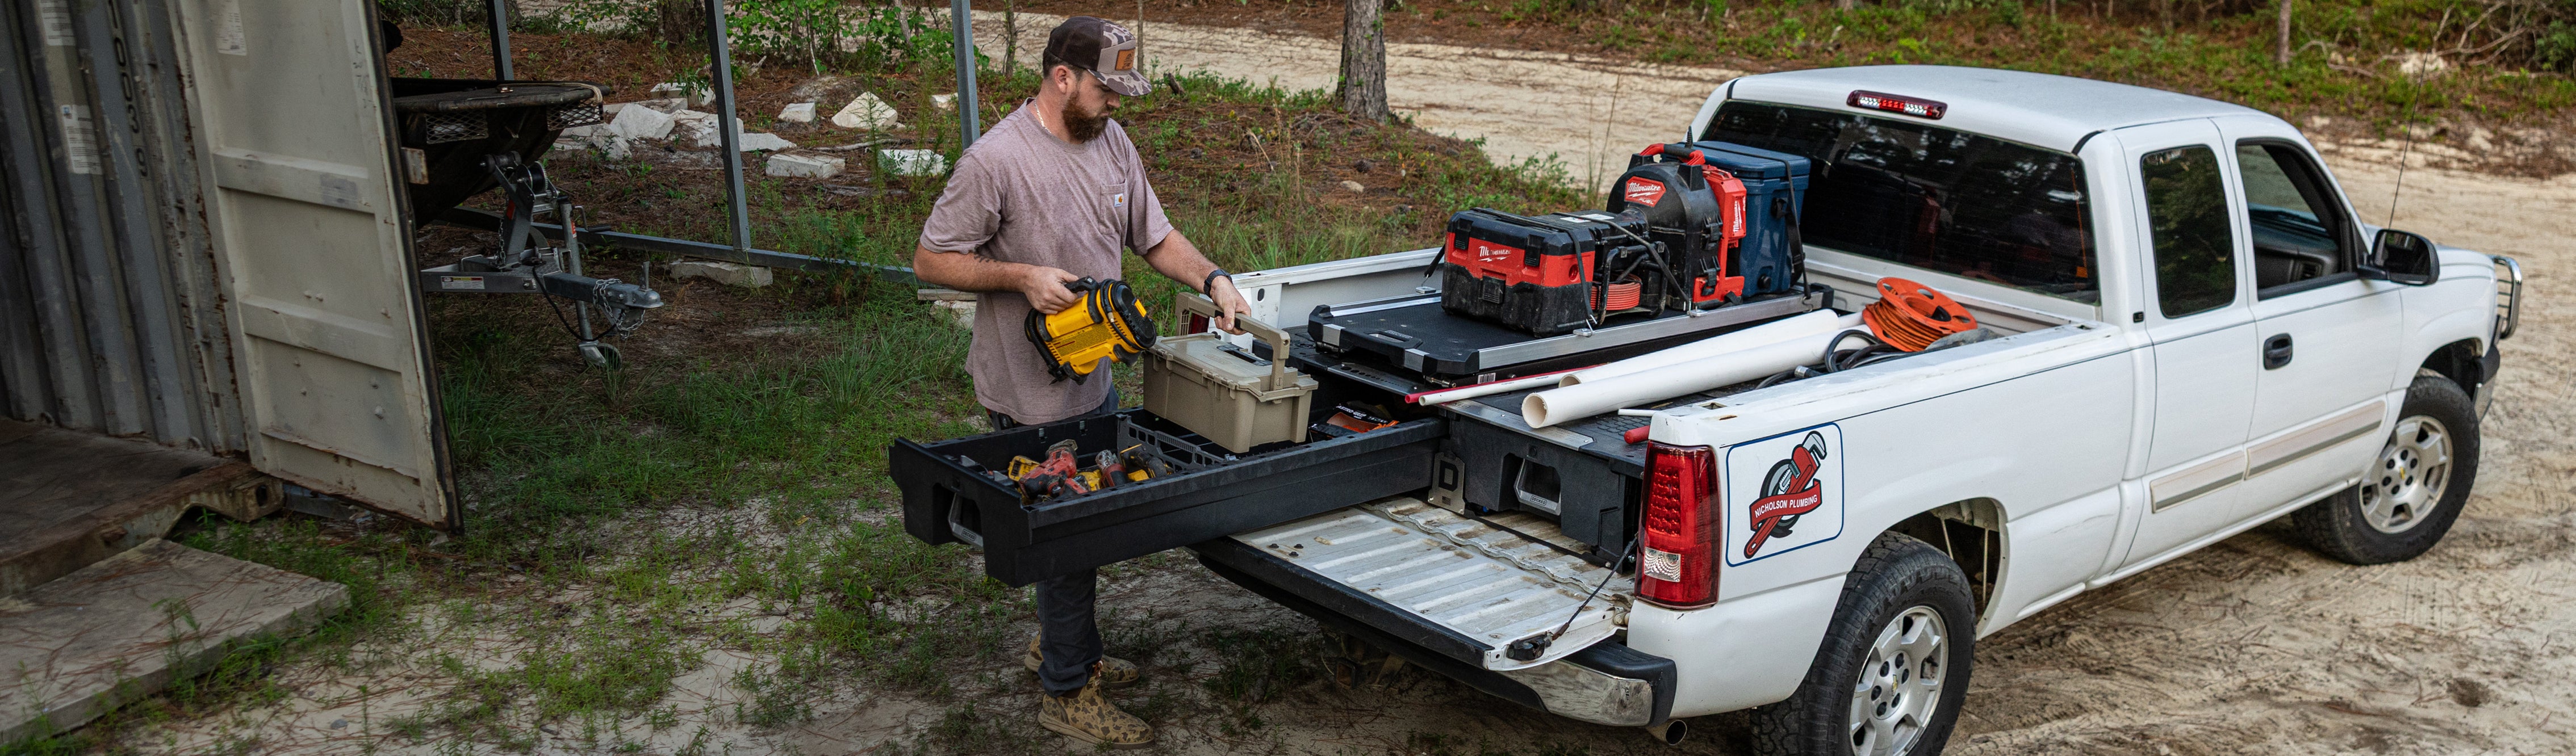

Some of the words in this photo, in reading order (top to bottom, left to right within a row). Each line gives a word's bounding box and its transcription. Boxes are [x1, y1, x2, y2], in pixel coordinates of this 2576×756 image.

[1628, 182, 1661, 192] Milwaukee
[1755, 500, 1788, 518] NICHOLSON
[1789, 494, 1817, 507] PLUMBING
